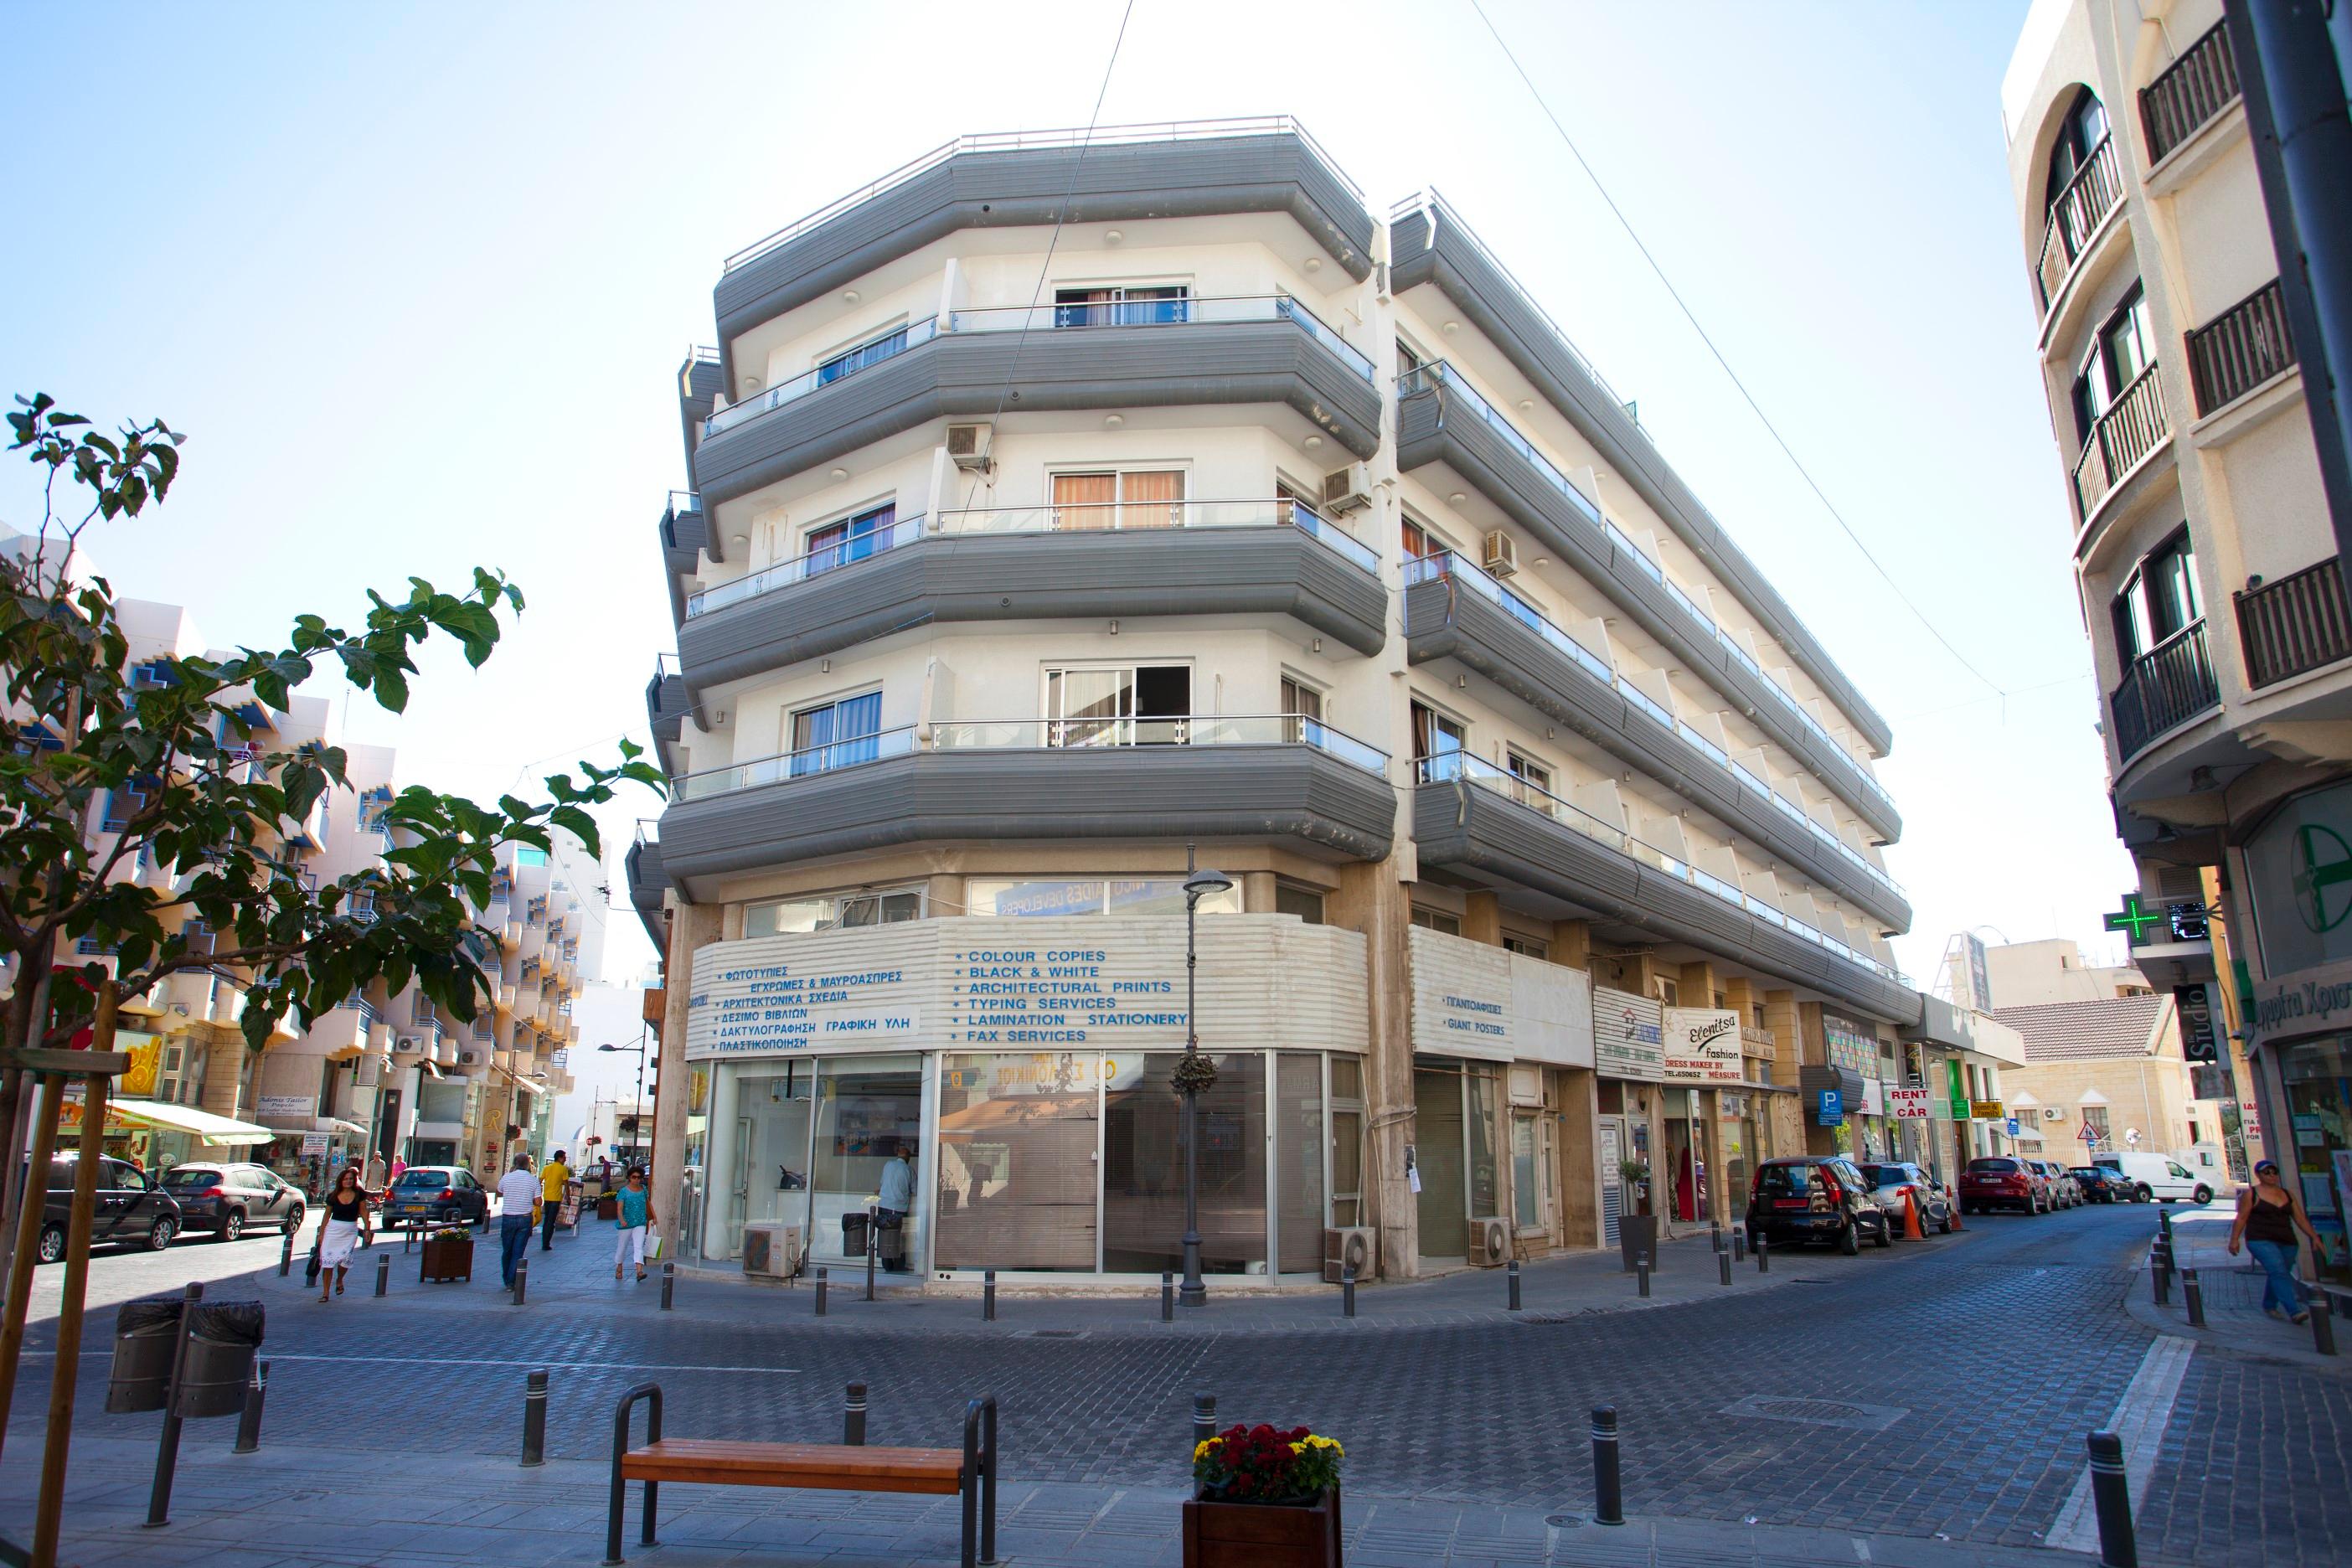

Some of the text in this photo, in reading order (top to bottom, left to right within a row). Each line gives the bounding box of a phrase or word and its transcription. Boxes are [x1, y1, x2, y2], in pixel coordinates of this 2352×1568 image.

[968, 951, 1106, 962] COLOUR COPIES
[725, 966, 787, 980] ΦΩΤΟΤΥΠΙΕΣ
[969, 967, 1100, 977] BLACK & WHITE
[750, 971, 903, 993] ΕΓΧΡΩΜΕΣ & ΜΑΥΡΟΑΣΠΡΕΣ
[969, 982, 1171, 993] ARCHITECTURAL PRINTS
[722, 991, 848, 1009] ΑΡΧΙΤΕΚΤΟΝΙΚΑ ΣΧΕΔΙΑ
[969, 998, 1117, 1009] TYPING SERVICES
[721, 1008, 807, 1023] ΔΕΣΙΜΟ ΒΙΒΛΙΩΝ
[968, 1014, 1065, 1025] LAMINATION
[1088, 1014, 1188, 1025] STATIONERY
[720, 1023, 816, 1037] ΔΑΚΤΥΛΟΓΡΑΦΗΣΗ
[826, 1018, 910, 1032] ΓΡΑΦΙΚΗ ΥΛΗ
[1448, 1019, 1504, 1035] GIANT POSTERS
[1689, 1016, 1736, 1043] Elenitsa
[967, 1030, 1086, 1041] FAX SERVICES
[720, 1038, 807, 1051] ΠΛΑΣΤΙΚΟΠΟΙΗΣΗ
[1706, 1047, 1739, 1059] fashion
[1689, 1060, 1712, 1069] MAKER
[1709, 1071, 1741, 1080] MEASURE
[1824, 1092, 1836, 1107] P
[1891, 1090, 1928, 1099] RENT
[1897, 1108, 1926, 1117] CAR
